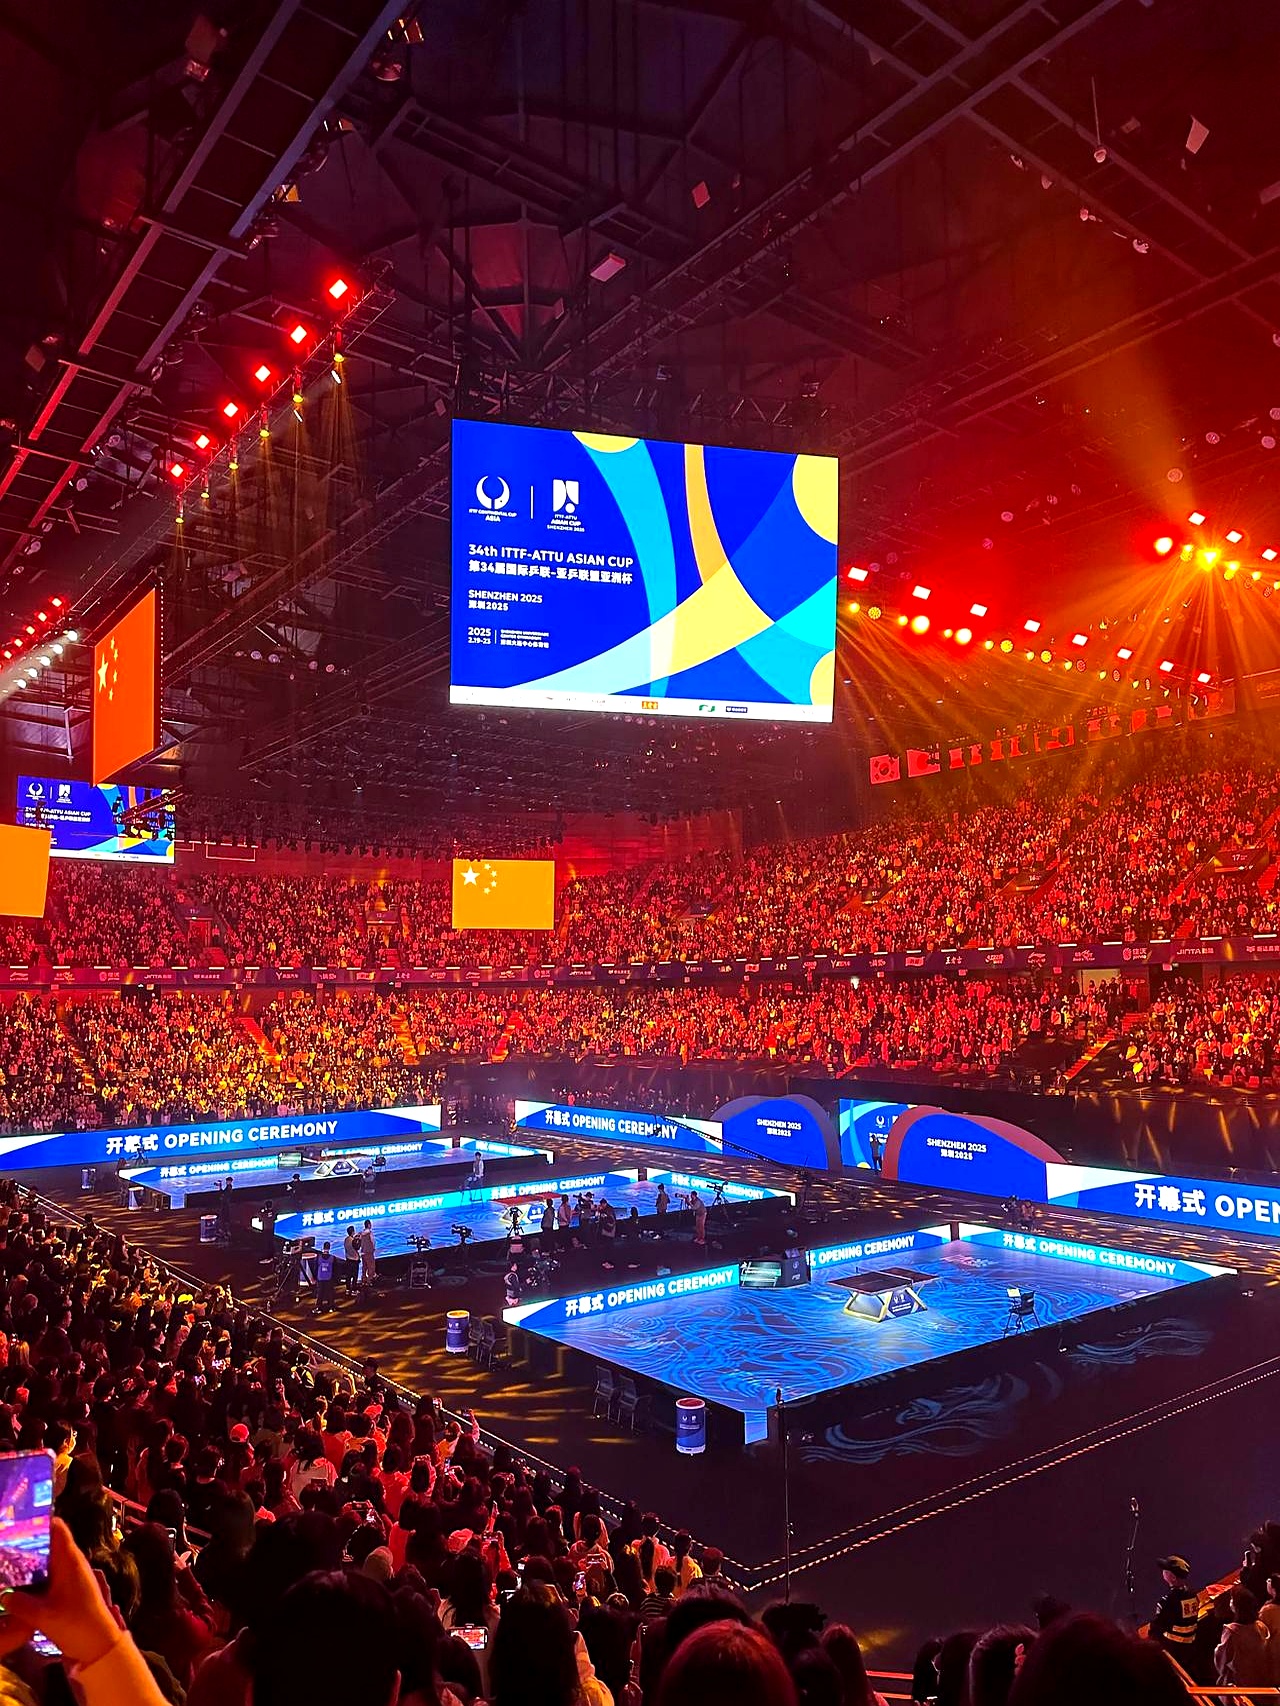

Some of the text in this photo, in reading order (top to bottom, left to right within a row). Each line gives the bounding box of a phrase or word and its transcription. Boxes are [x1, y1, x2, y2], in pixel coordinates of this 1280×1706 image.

[469, 544, 633, 568] 34th ITTF-ATTU ASIAN CUP
[468, 590, 542, 603] SHENZHEN 2025
[468, 600, 509, 611] 深圳2025
[468, 627, 491, 636] 2025
[545, 1109, 570, 1127] 开幕式
[572, 1114, 616, 1131] OPENING
[757, 1118, 802, 1130] SHENZHEN 2025
[106, 1121, 338, 1155] 开幕式 OPENING CEREMONY
[381, 1143, 423, 1154] CEREMONY
[927, 1137, 987, 1153] SHENZHEN 2025
[189, 1162, 230, 1174] OPENING
[519, 1182, 558, 1196] OPENING
[560, 1175, 606, 1189] CEREMONY
[1134, 1183, 1207, 1216] 开幕式
[302, 1197, 444, 1226] 开幕式 OPENING CEREMONY
[818, 1244, 863, 1264] OPENING
[864, 1234, 915, 1255] CEREMONY
[1003, 1233, 1177, 1276] 开幕式 OPENING CEREMONY
[565, 1293, 605, 1318] 开幕式
[607, 1282, 666, 1308] OPENING
[667, 1269, 734, 1295] CEREMONY
